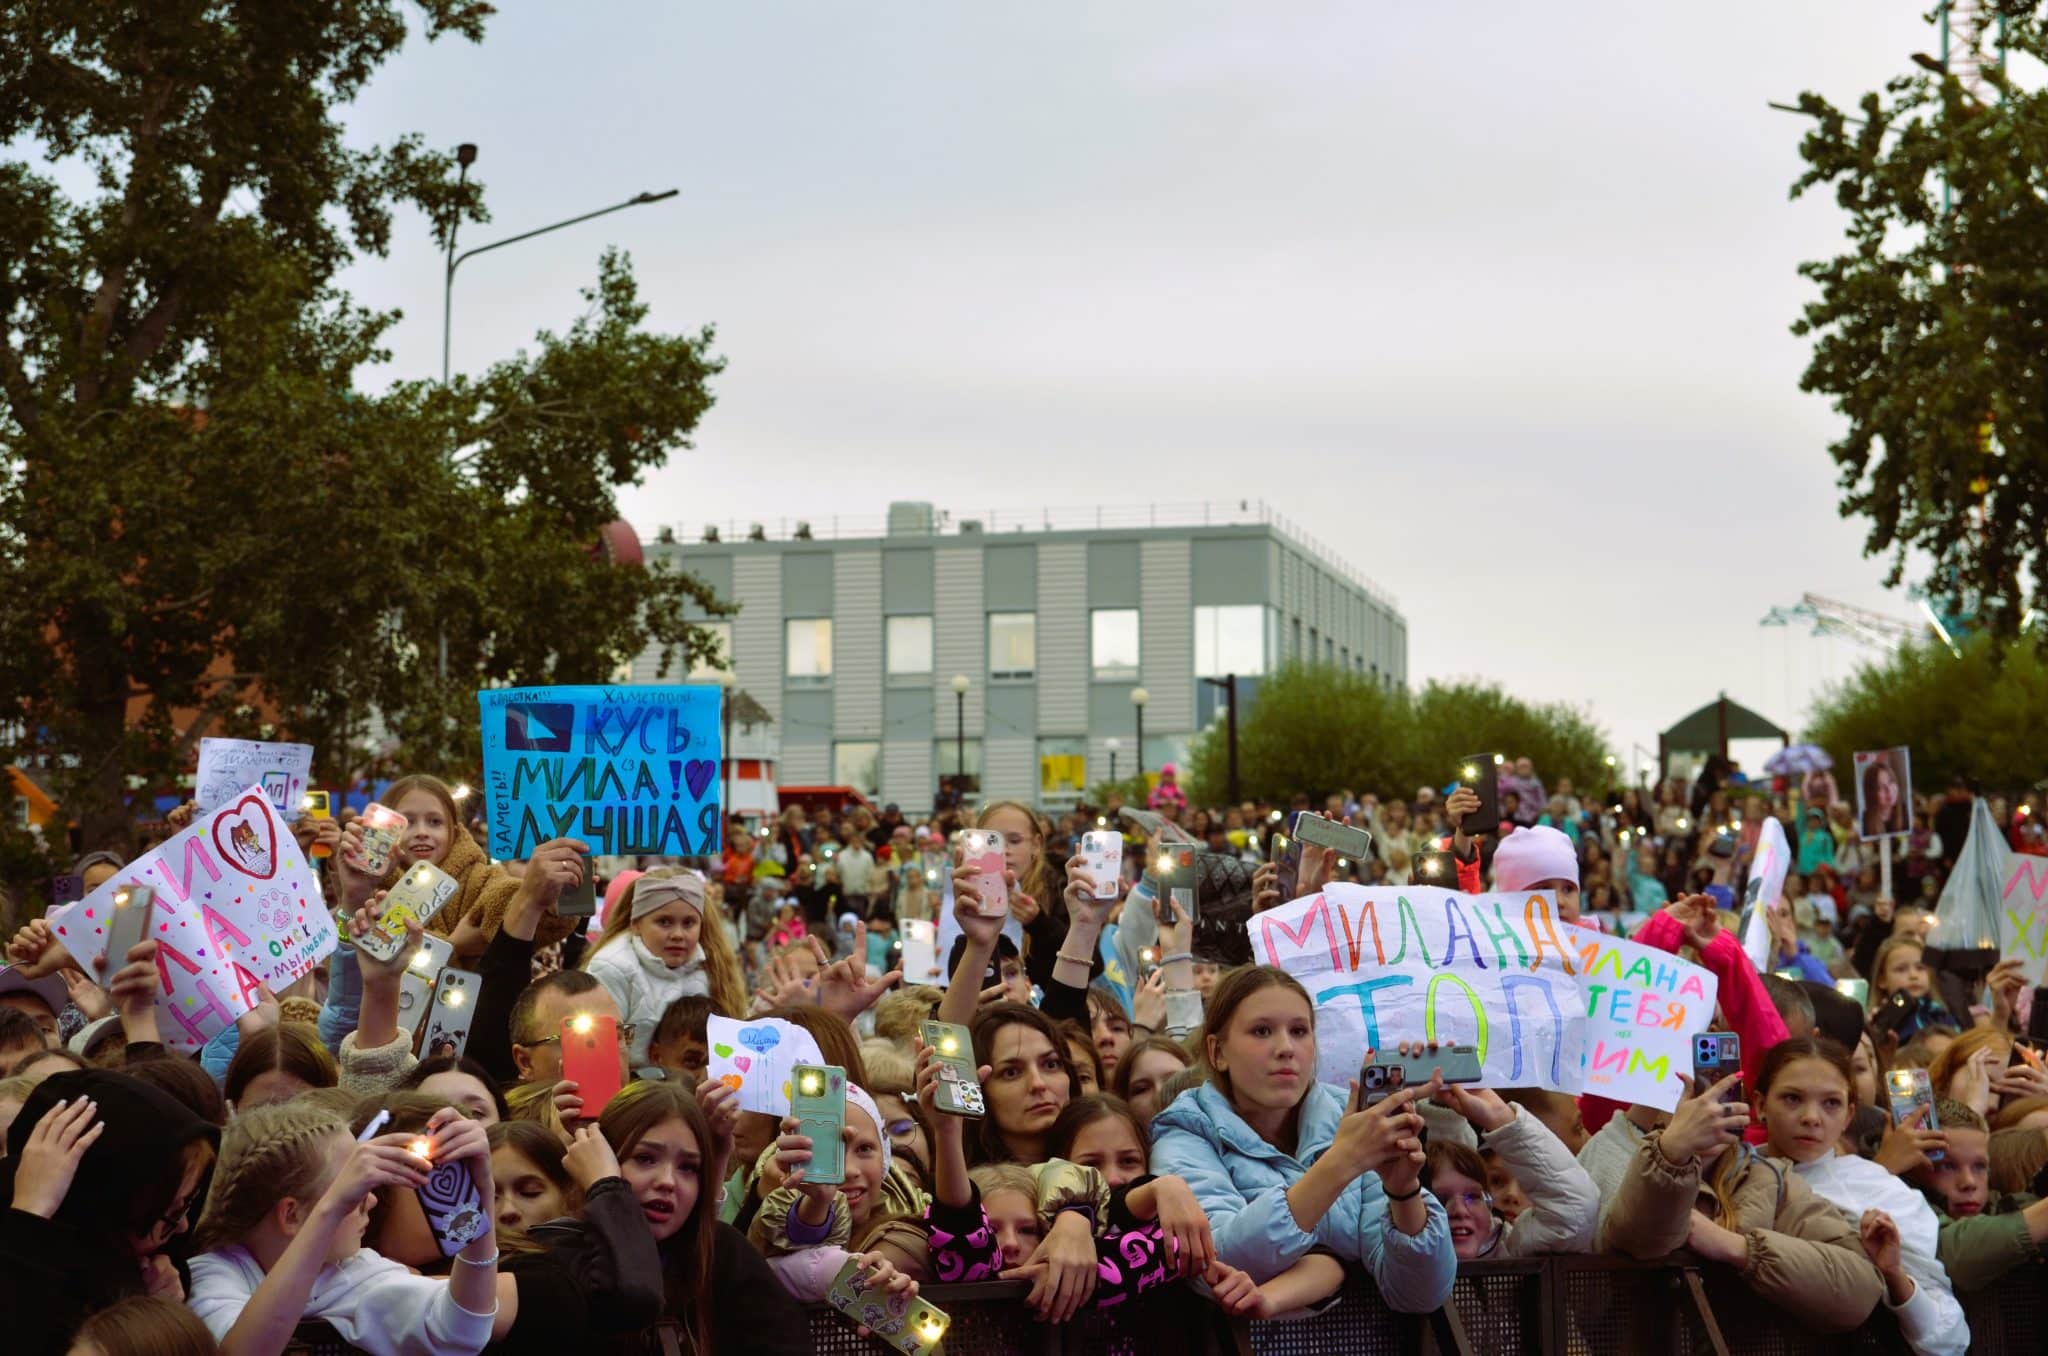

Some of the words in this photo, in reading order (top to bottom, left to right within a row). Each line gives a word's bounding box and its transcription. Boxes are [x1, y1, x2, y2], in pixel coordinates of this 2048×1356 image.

[585, 704, 691, 756] КУСЬ
[513, 803, 720, 859] ЛУЧШАЯ
[1261, 894, 1576, 976] МИЛАНА
[1316, 972, 1562, 1087] ТОП
[1586, 984, 1686, 1032] ТЕБЯ
[1581, 1040, 1670, 1083] ИМ
